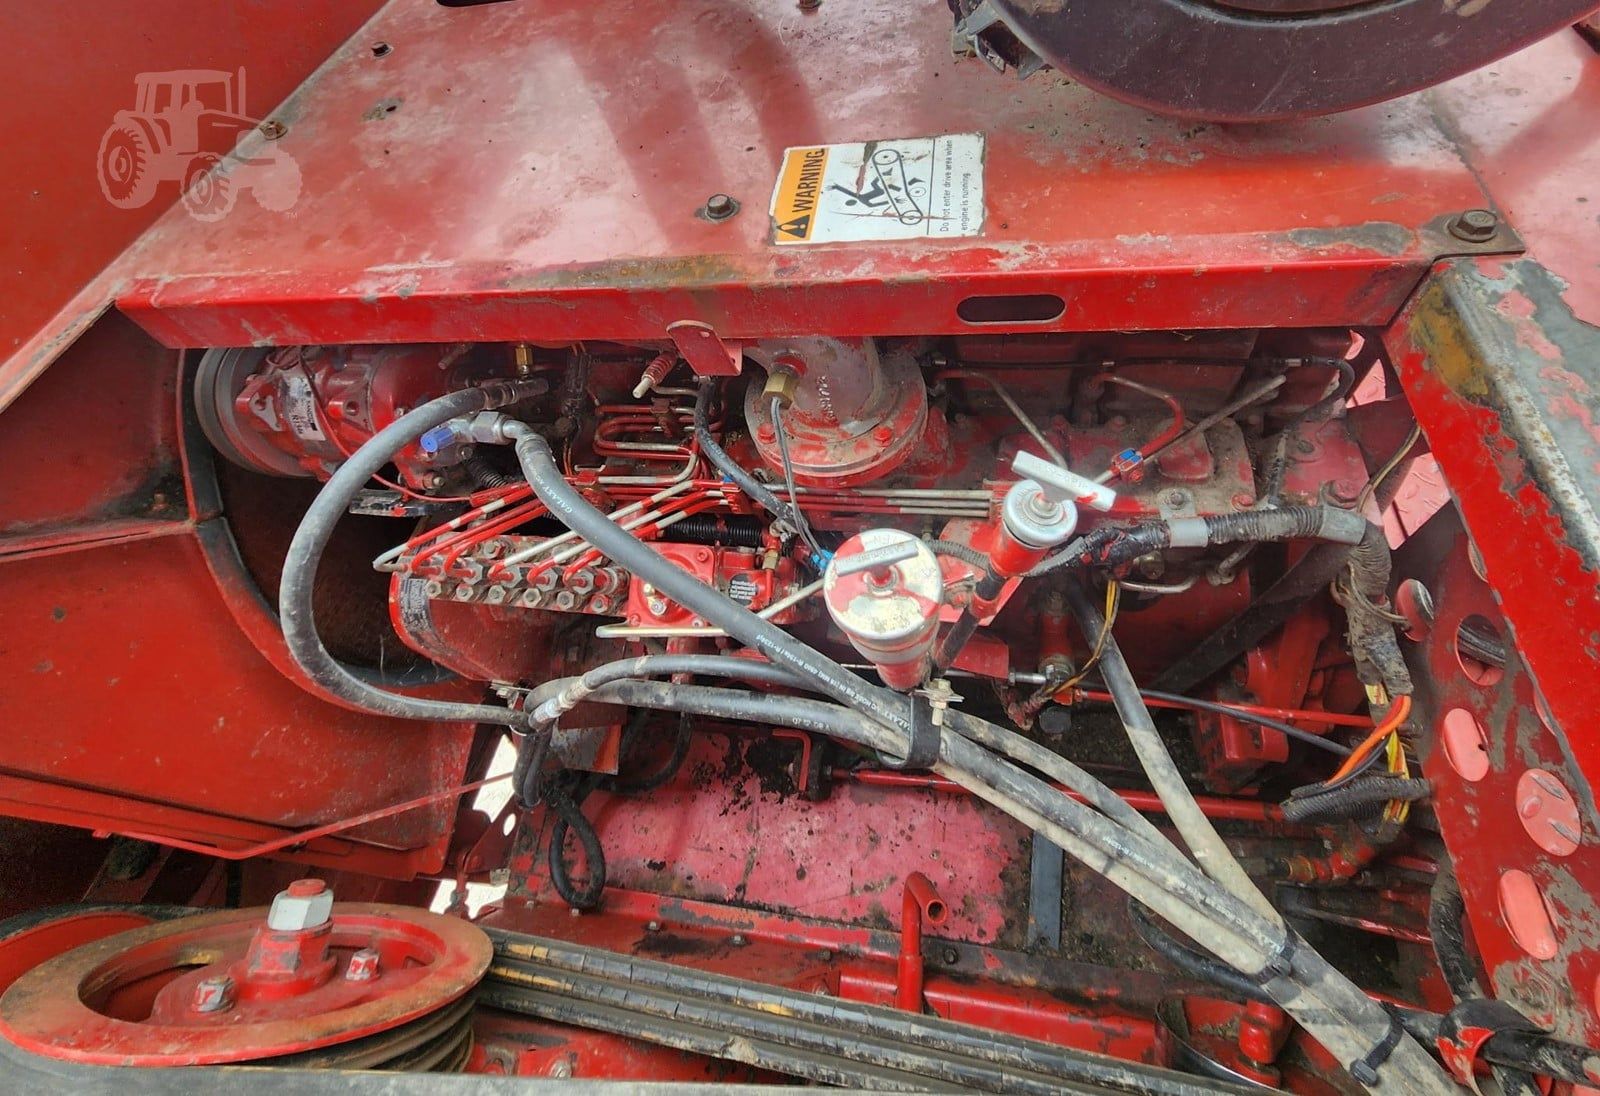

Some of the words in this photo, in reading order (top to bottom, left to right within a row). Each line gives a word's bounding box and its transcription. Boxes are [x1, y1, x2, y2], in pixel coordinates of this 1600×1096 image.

[945, 140, 953, 156] when
[792, 148, 825, 213] WARNING
[943, 172, 951, 188] drive
[943, 190, 951, 207] enter
[961, 206, 970, 231] engine
[940, 222, 950, 232] Do
